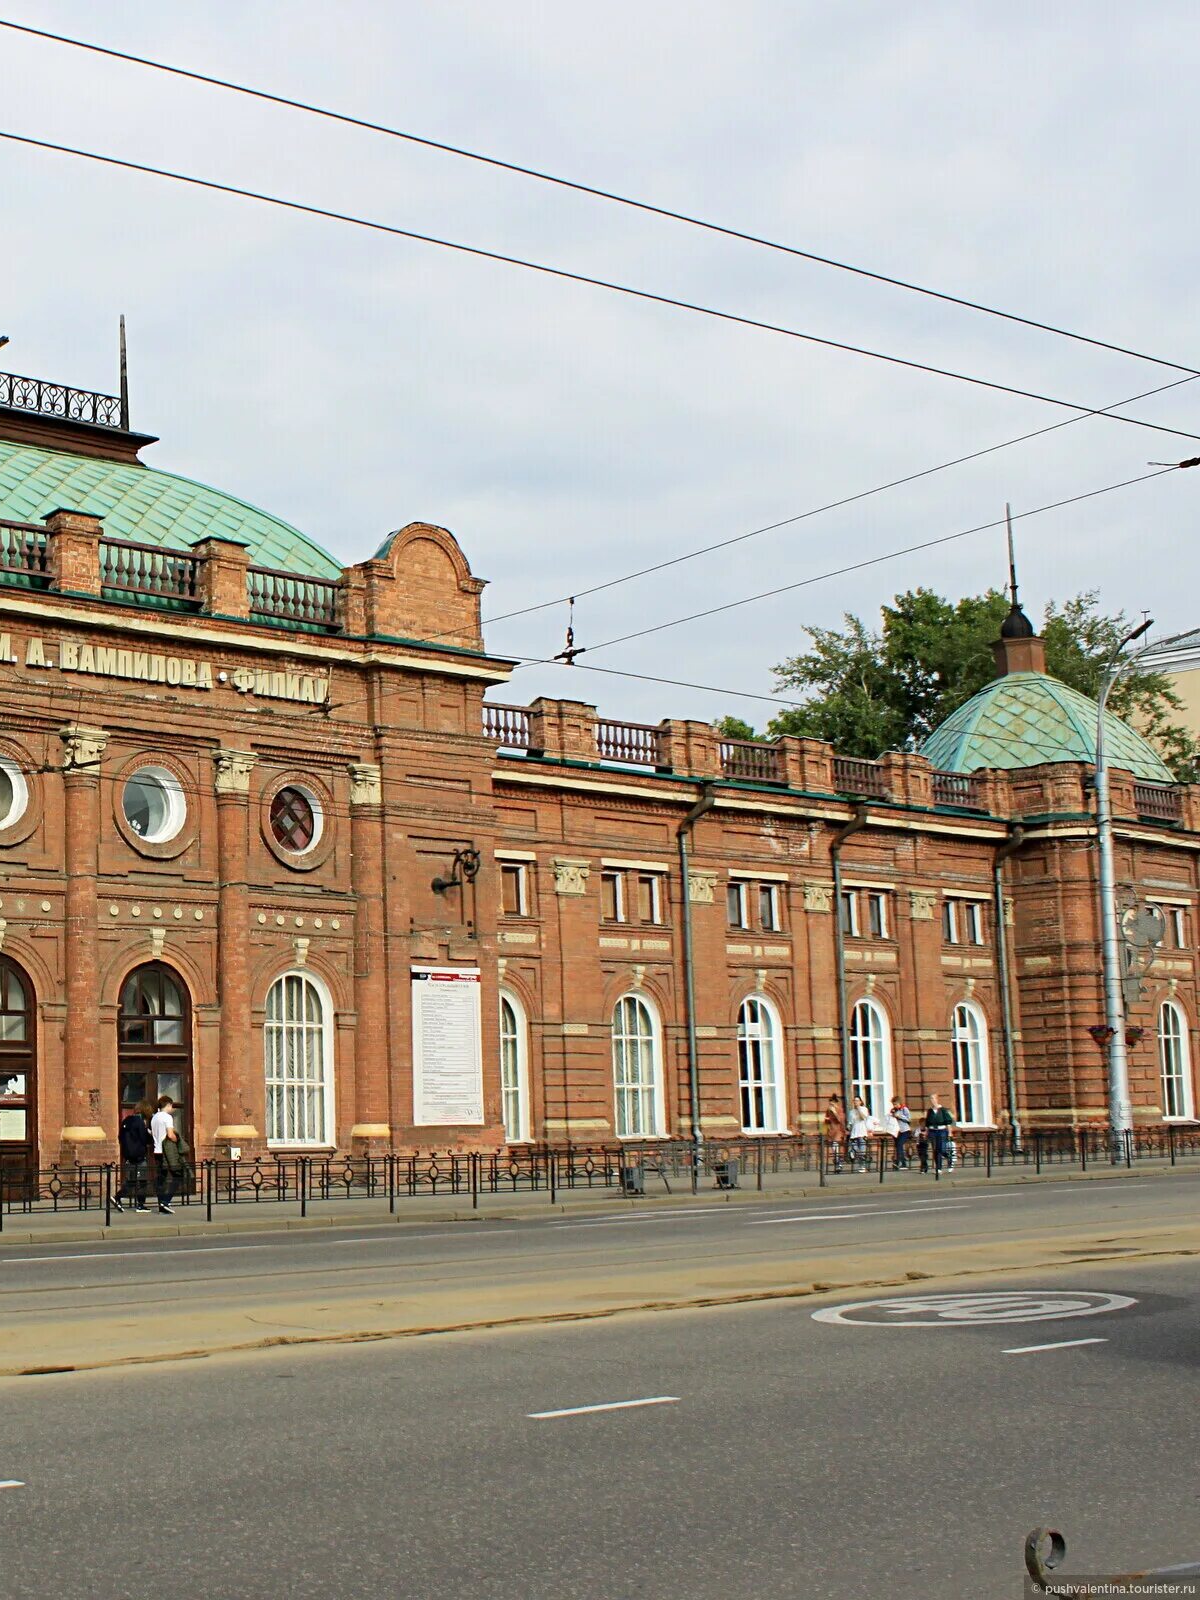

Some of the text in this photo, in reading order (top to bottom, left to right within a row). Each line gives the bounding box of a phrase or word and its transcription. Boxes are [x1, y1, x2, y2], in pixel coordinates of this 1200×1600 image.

[25, 637, 53, 668] А.
[59, 641, 213, 690] ВАМПИЛОВА
[231, 667, 331, 705] ФИЛИАЛ
